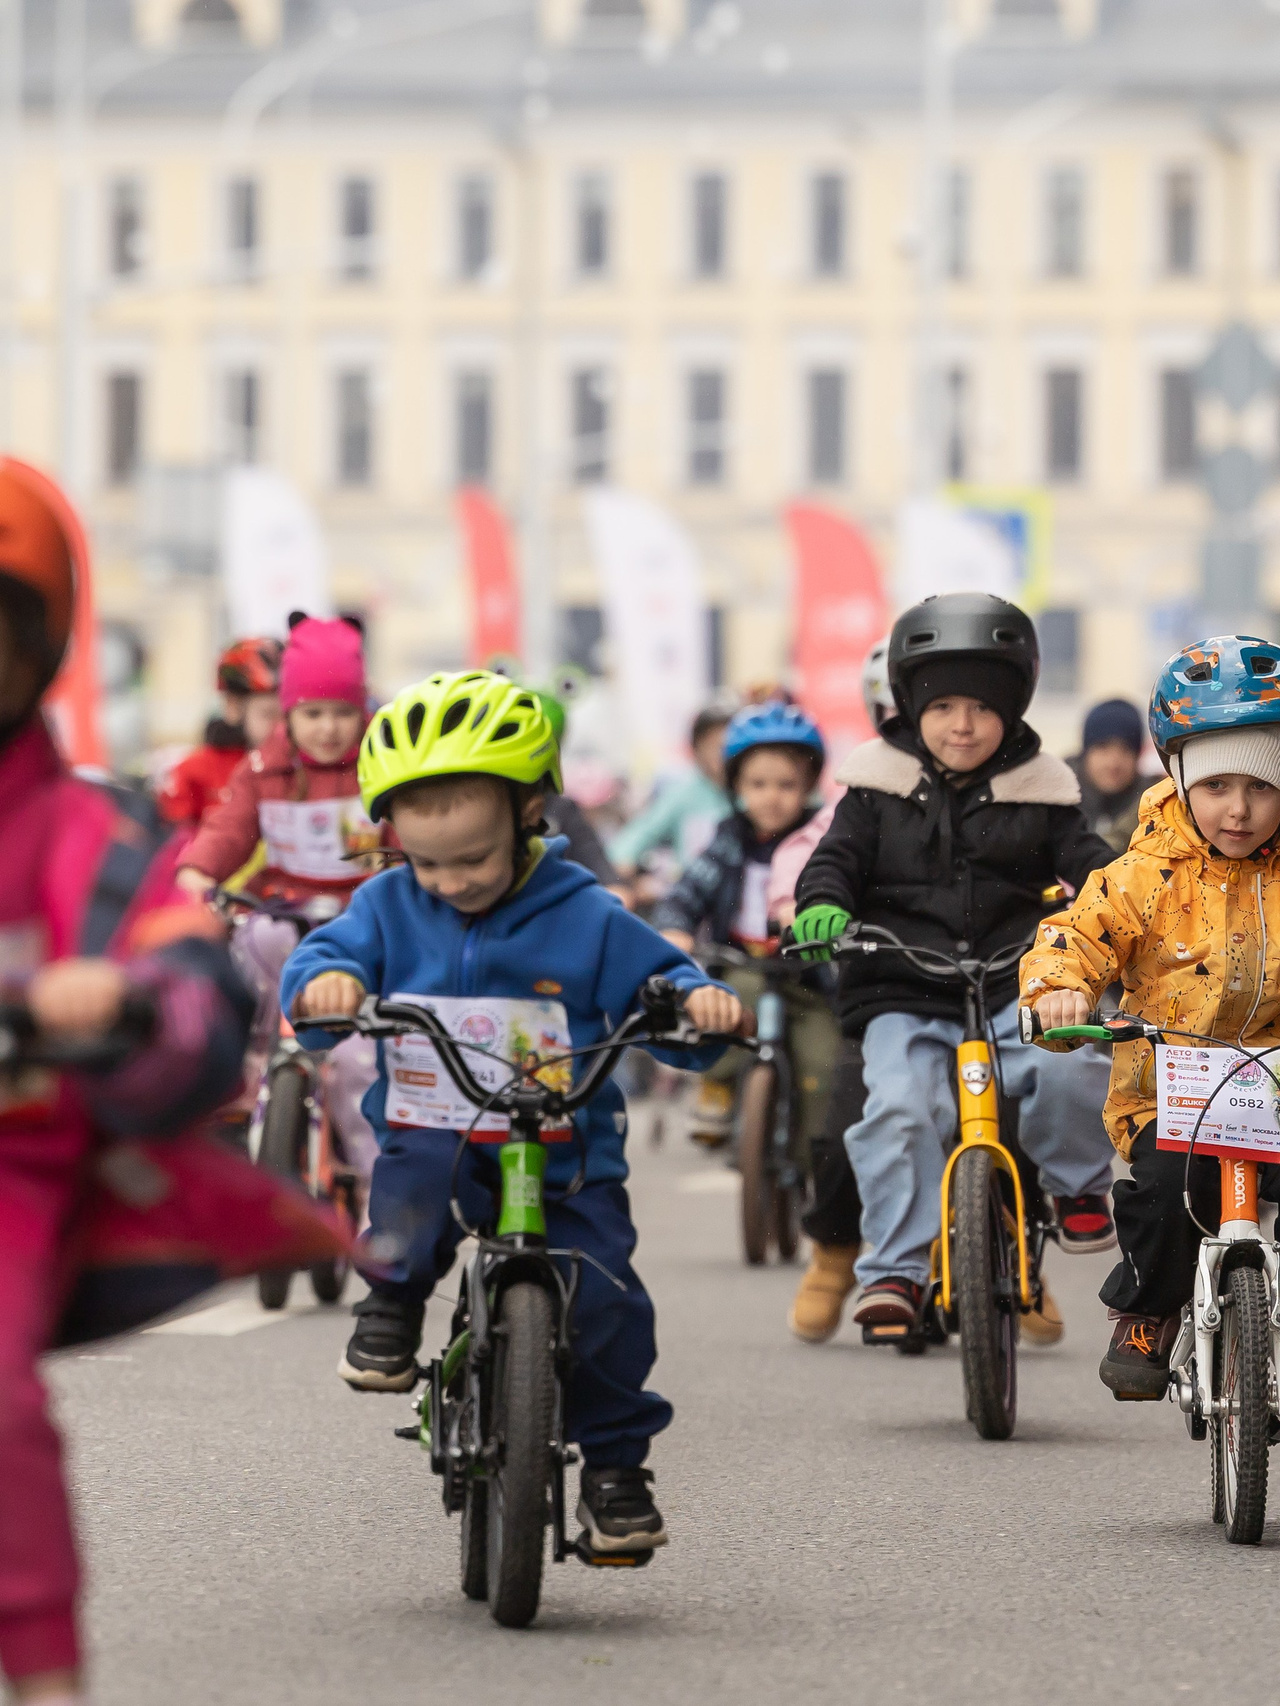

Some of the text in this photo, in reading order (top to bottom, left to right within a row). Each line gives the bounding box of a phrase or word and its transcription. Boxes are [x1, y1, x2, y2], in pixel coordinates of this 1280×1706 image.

[1166, 1049, 1192, 1057] ЛЕТО
[1229, 1097, 1264, 1109] 0582
[1233, 1158, 1246, 1209] woom
